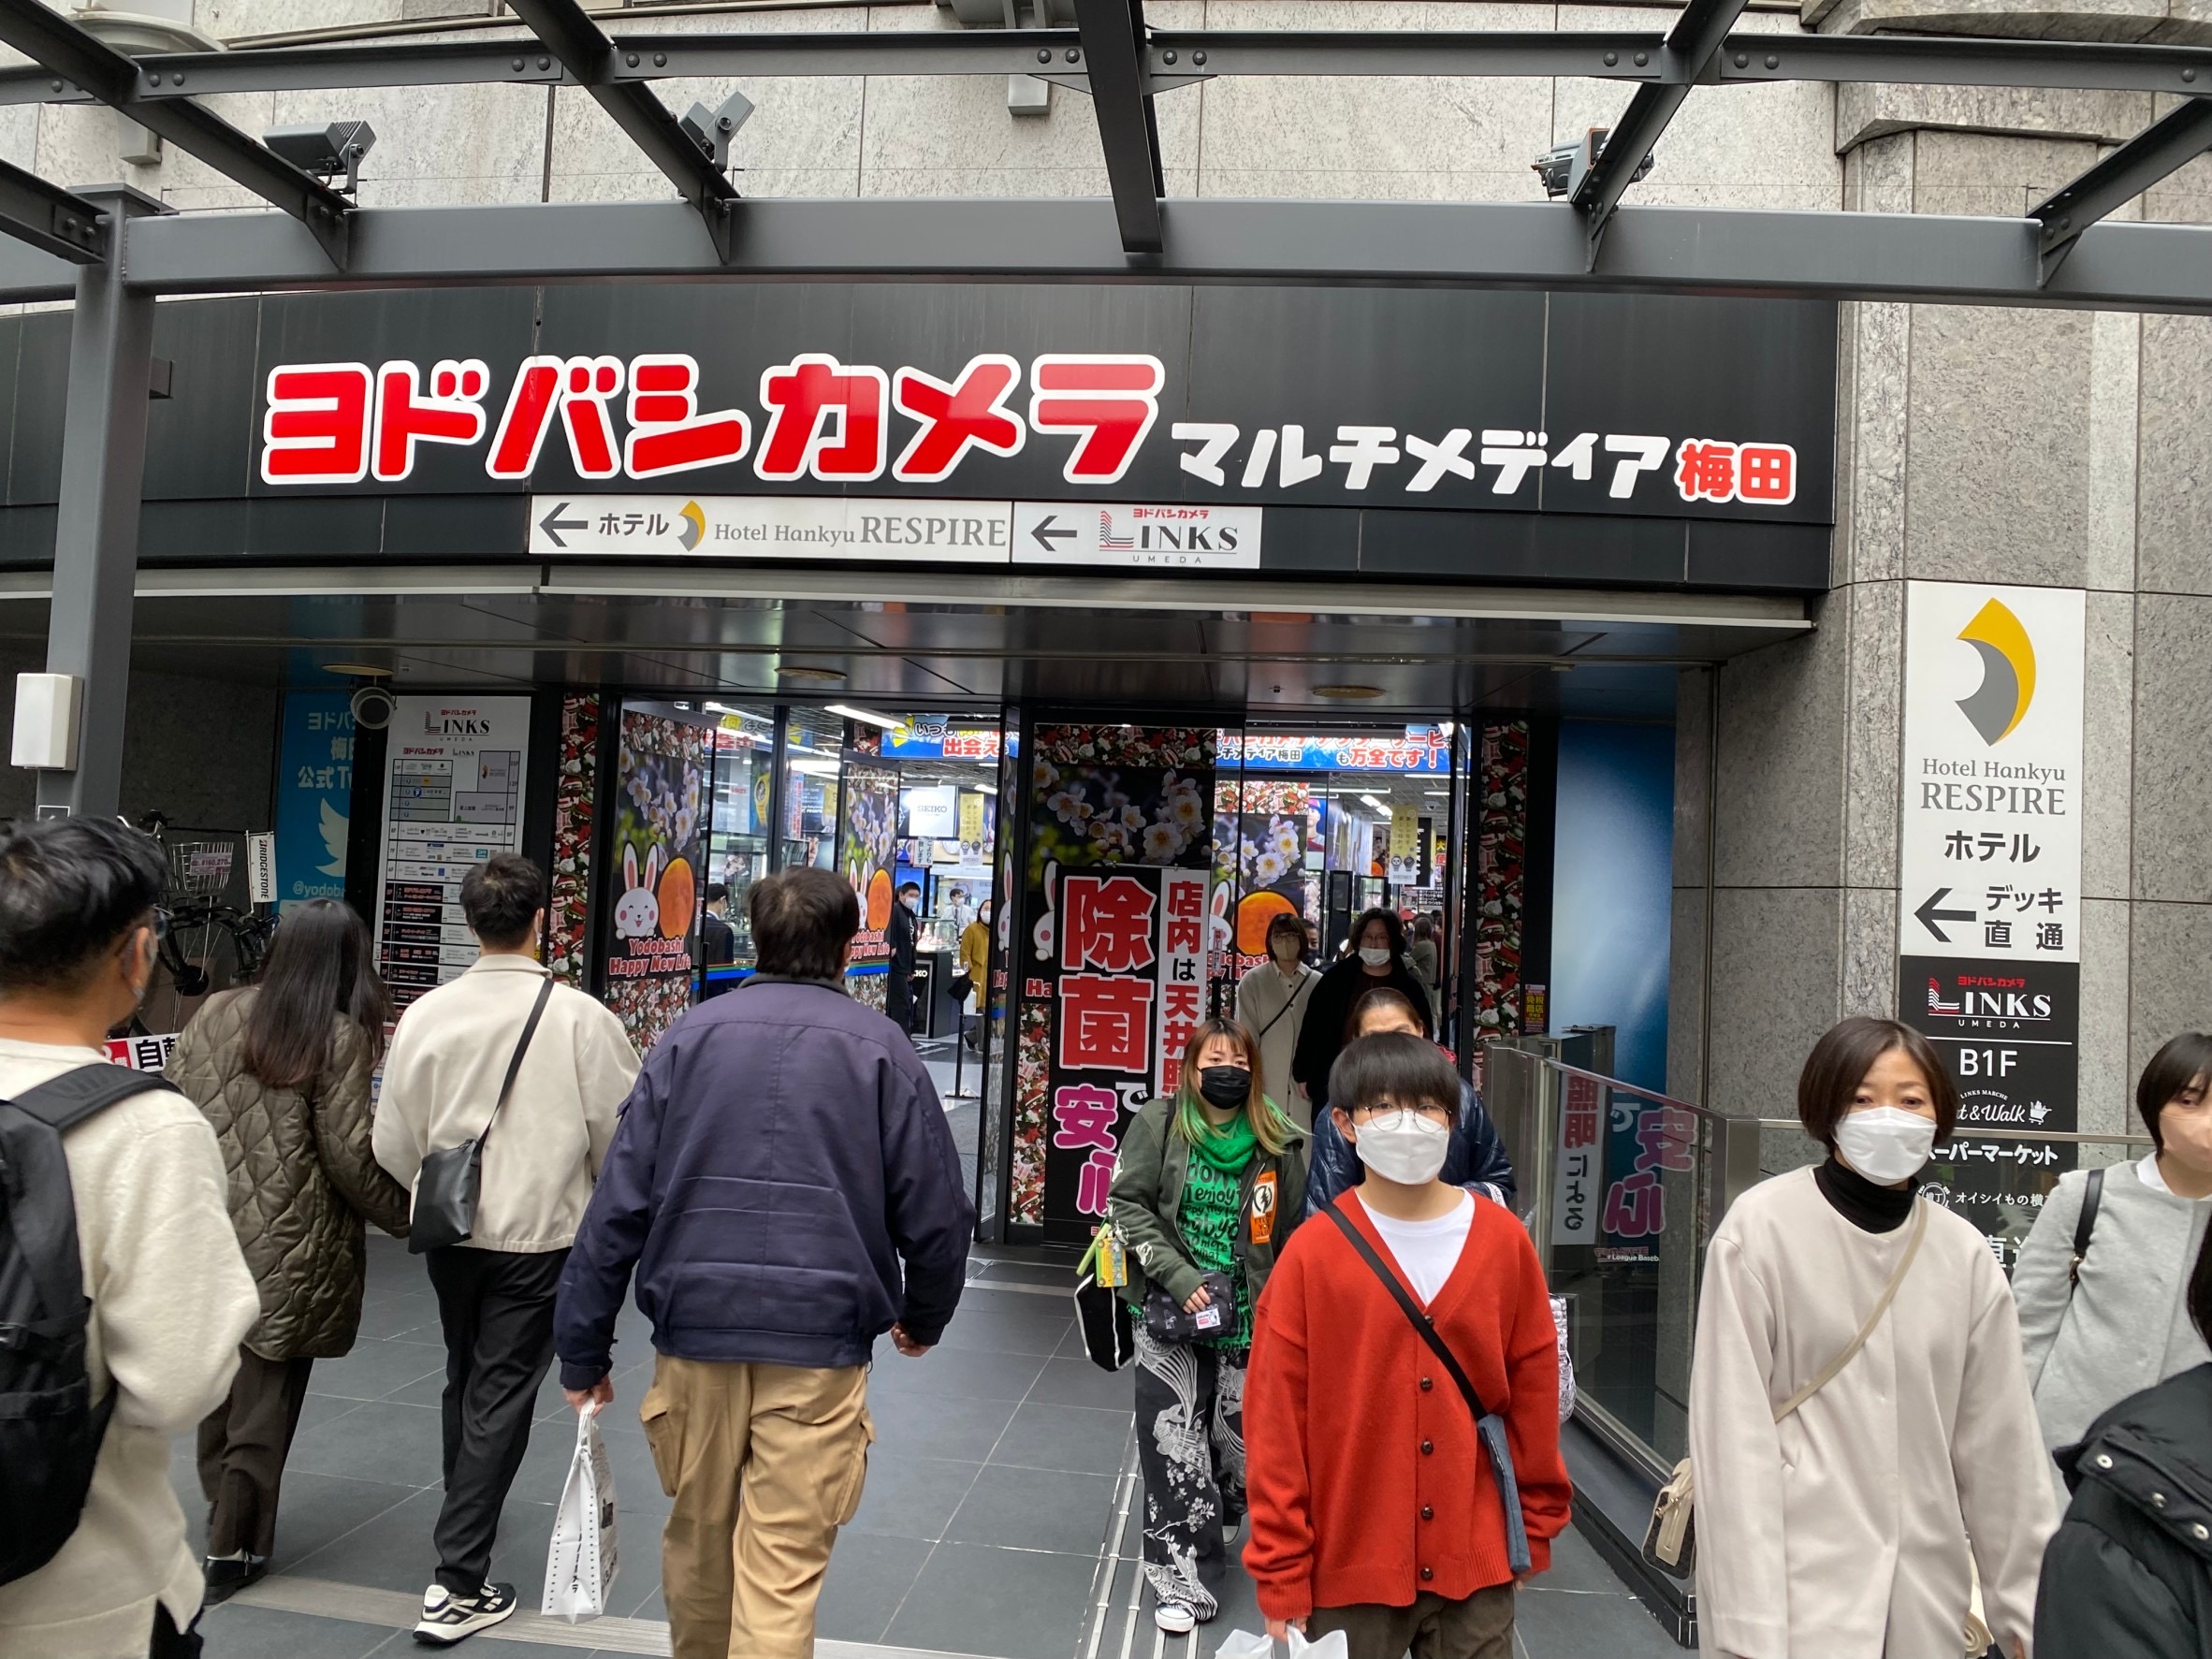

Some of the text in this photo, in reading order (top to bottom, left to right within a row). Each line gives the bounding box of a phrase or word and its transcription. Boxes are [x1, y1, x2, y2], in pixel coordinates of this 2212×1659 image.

[260, 353, 1166, 486] ヨドバシカメラ
[599, 513, 670, 536] ホテル
[1133, 508, 1209, 519] ヨドバシカメラ
[714, 516, 1007, 547] Hotel Hankyu RESPIRE
[1099, 510, 1238, 550] LINKS
[1132, 555, 1201, 563] UMEDA
[424, 711, 490, 735] LINKS
[1922, 758, 2066, 785] Hotel Hankyu
[917, 805, 947, 813] SEIKO
[1921, 782, 2066, 816] RESPIRE
[1944, 830, 2041, 863] ホテル
[1986, 884, 2063, 914] デッキ
[629, 937, 684, 955] Yodobashi
[1985, 920, 2064, 951] 直通
[609, 957, 649, 977] Happy
[650, 955, 676, 972] New
[1058, 876, 1157, 1074] 除菌
[1957, 976, 2026, 988] ヨドバシカメラ
[1928, 978, 2051, 1017] LINKS
[1958, 1019, 2020, 1029] UMEDA
[1959, 1048, 2017, 1077] B1F
[1960, 1089, 2009, 1101] LINKS MARCHE
[1195, 1186, 1235, 1205] enjoy
[1955, 1192, 2049, 1207] オイシイもの横
